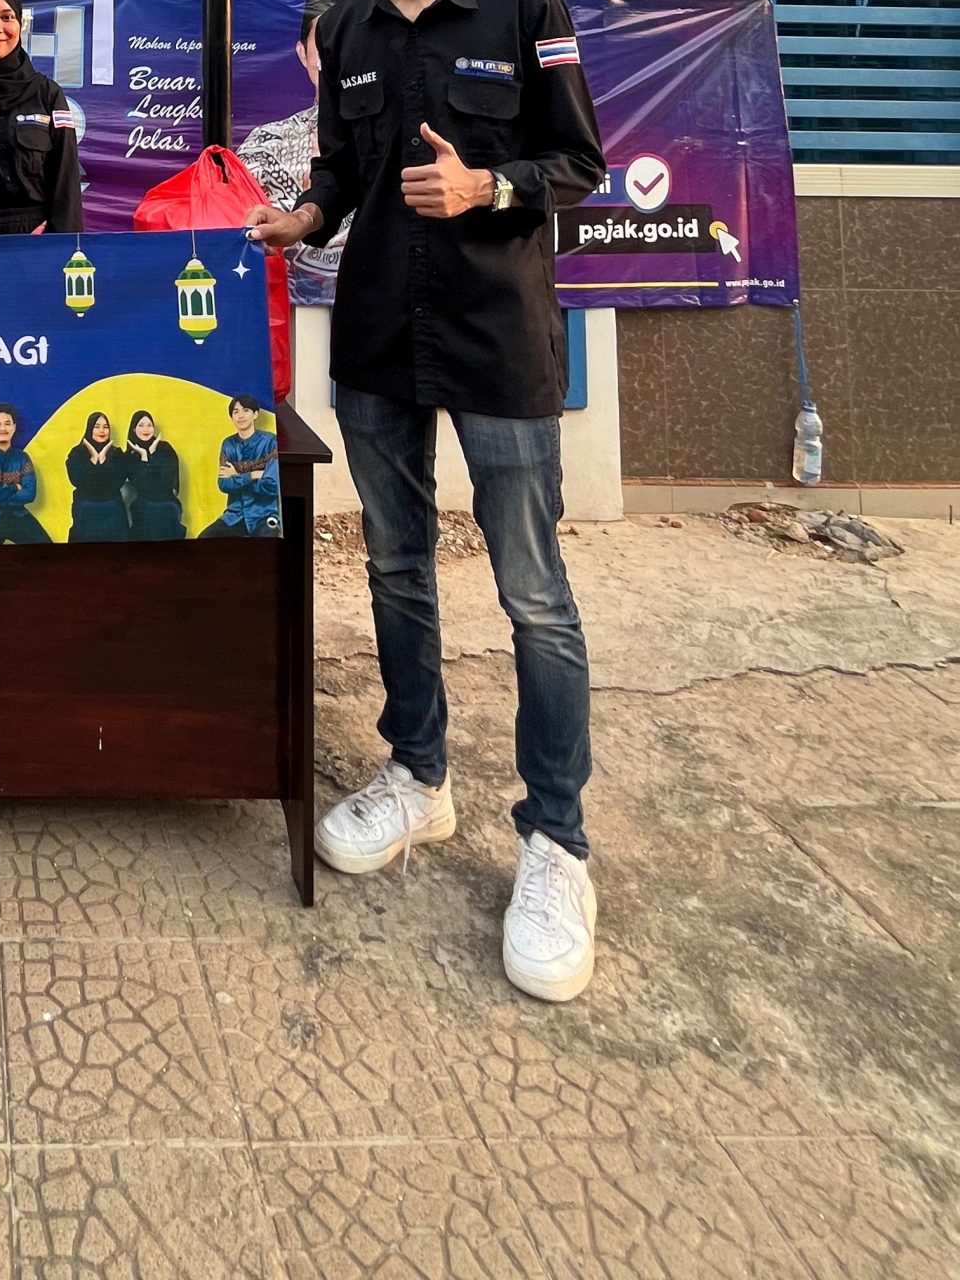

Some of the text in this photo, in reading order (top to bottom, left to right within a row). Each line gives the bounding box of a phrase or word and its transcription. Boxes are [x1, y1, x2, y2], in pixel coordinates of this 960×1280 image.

[128, 35, 172, 51] Mohon
[175, 37, 203, 53] lapo
[125, 125, 191, 159] Jelas.
[578, 216, 699, 245] pajak.go.id
